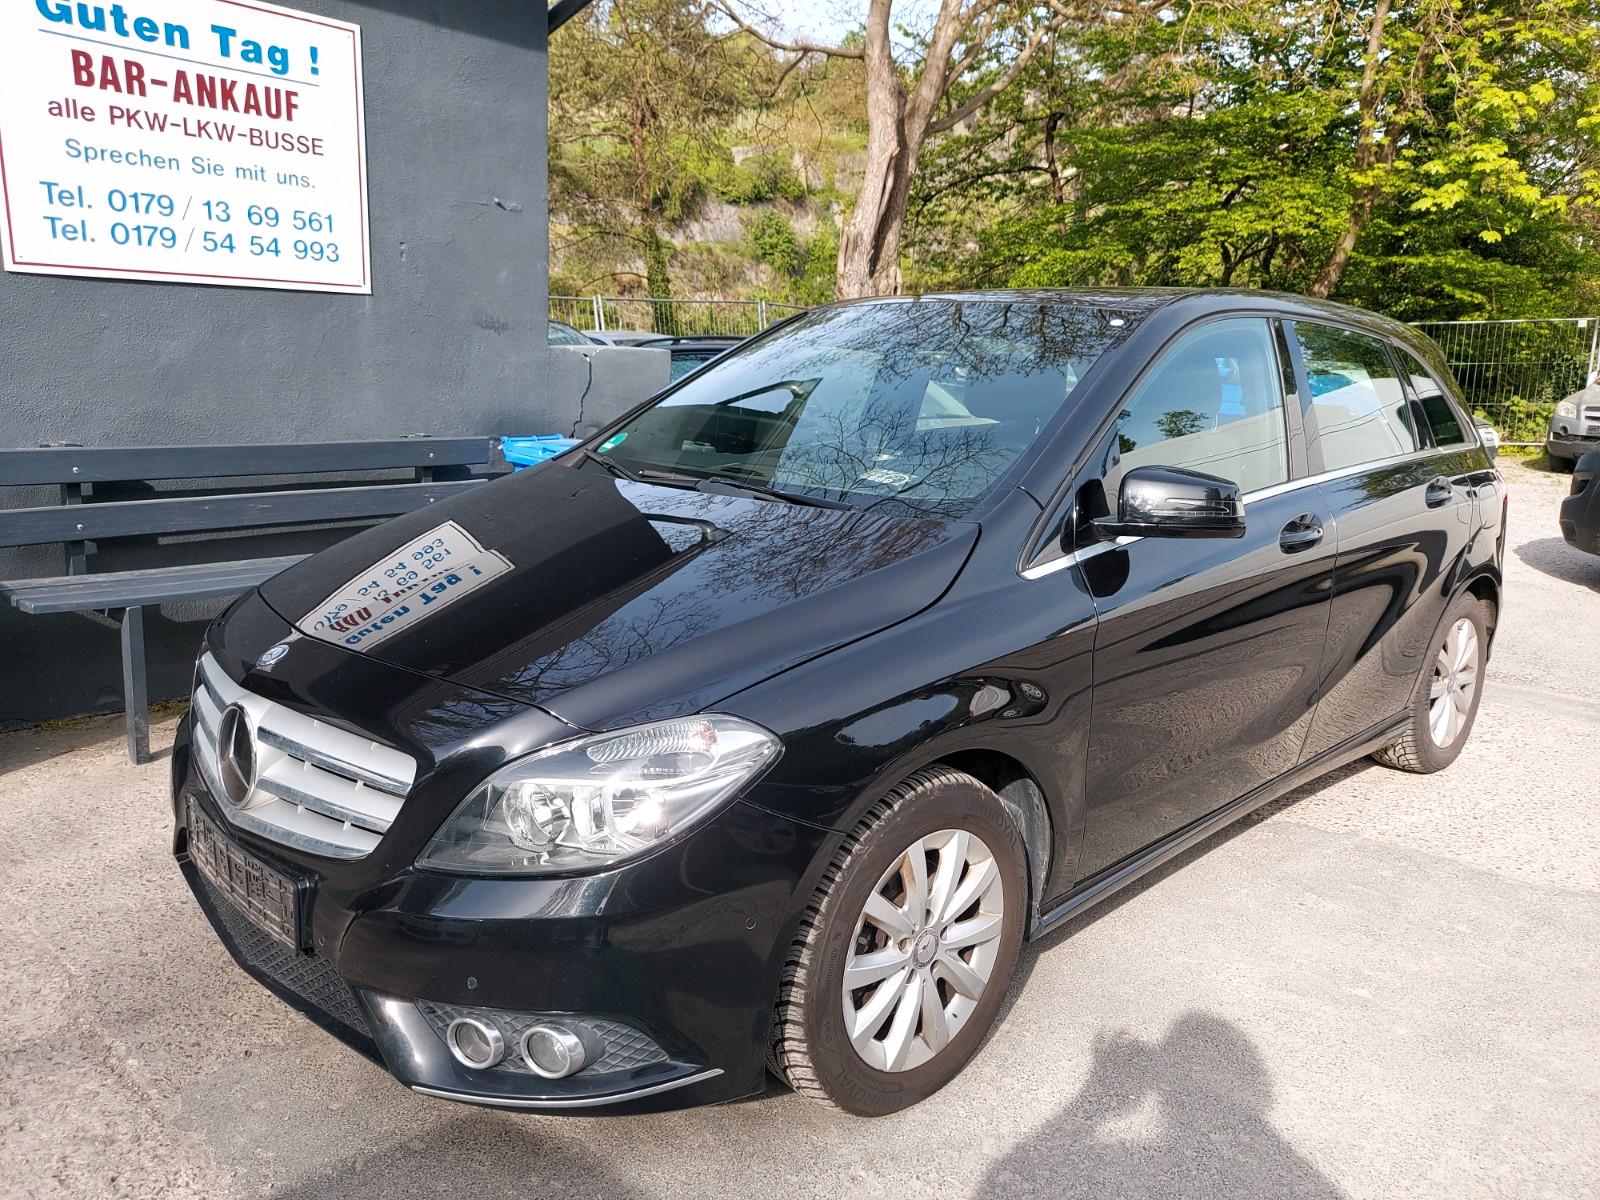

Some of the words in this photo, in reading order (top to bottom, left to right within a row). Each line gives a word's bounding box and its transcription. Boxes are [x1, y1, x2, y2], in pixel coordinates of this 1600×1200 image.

[34, 0, 190, 49] Guten
[211, 24, 289, 75] Tag
[71, 49, 299, 121] BAR-ANKAUF
[48, 98, 96, 122] alle
[109, 105, 324, 156] PKW-LKW-BUSSE
[65, 139, 181, 171] Sprechen
[192, 156, 225, 177] Sie
[235, 166, 267, 182] mit
[276, 173, 316, 188] uns.
[39, 181, 93, 208] Tel.
[248, 205, 280, 227] 69
[293, 210, 333, 233] 561
[43, 216, 96, 242] Tel.
[250, 236, 282, 257] 54
[294, 240, 340, 262] 993
